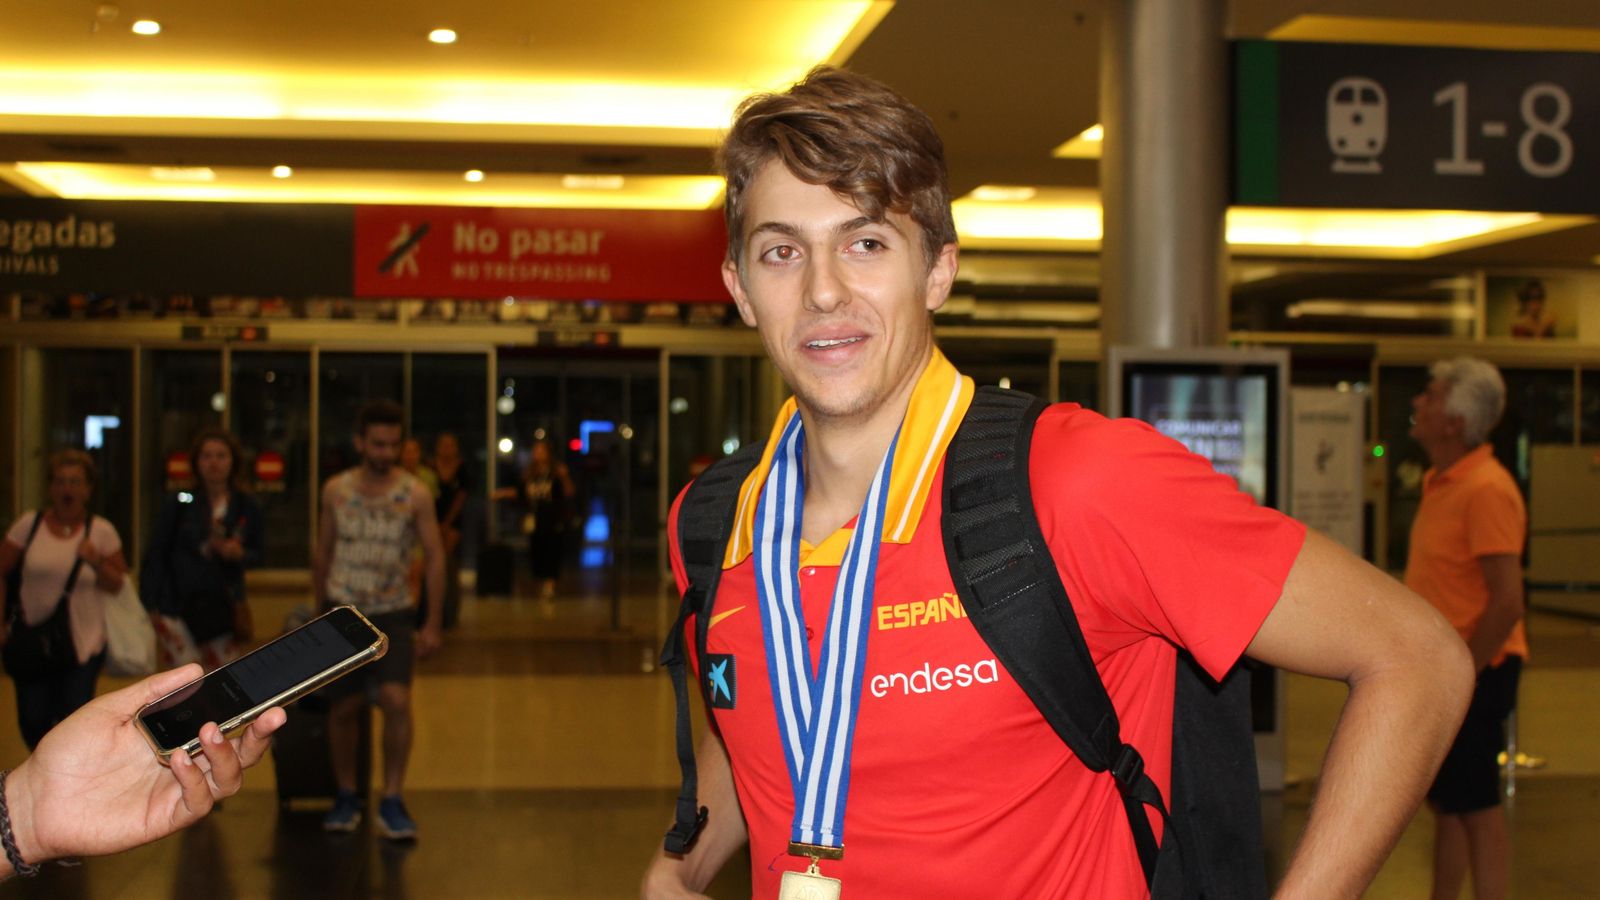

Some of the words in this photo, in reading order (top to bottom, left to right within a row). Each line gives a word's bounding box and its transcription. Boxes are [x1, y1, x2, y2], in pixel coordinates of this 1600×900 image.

[1433, 80, 1574, 177] 1-8
[453, 222, 499, 254] No
[510, 228, 605, 261] pasar
[0, 255, 58, 275] IVALS
[452, 262, 479, 281] NO
[484, 261, 611, 284] TRESPASSING
[870, 659, 999, 698] endesa
